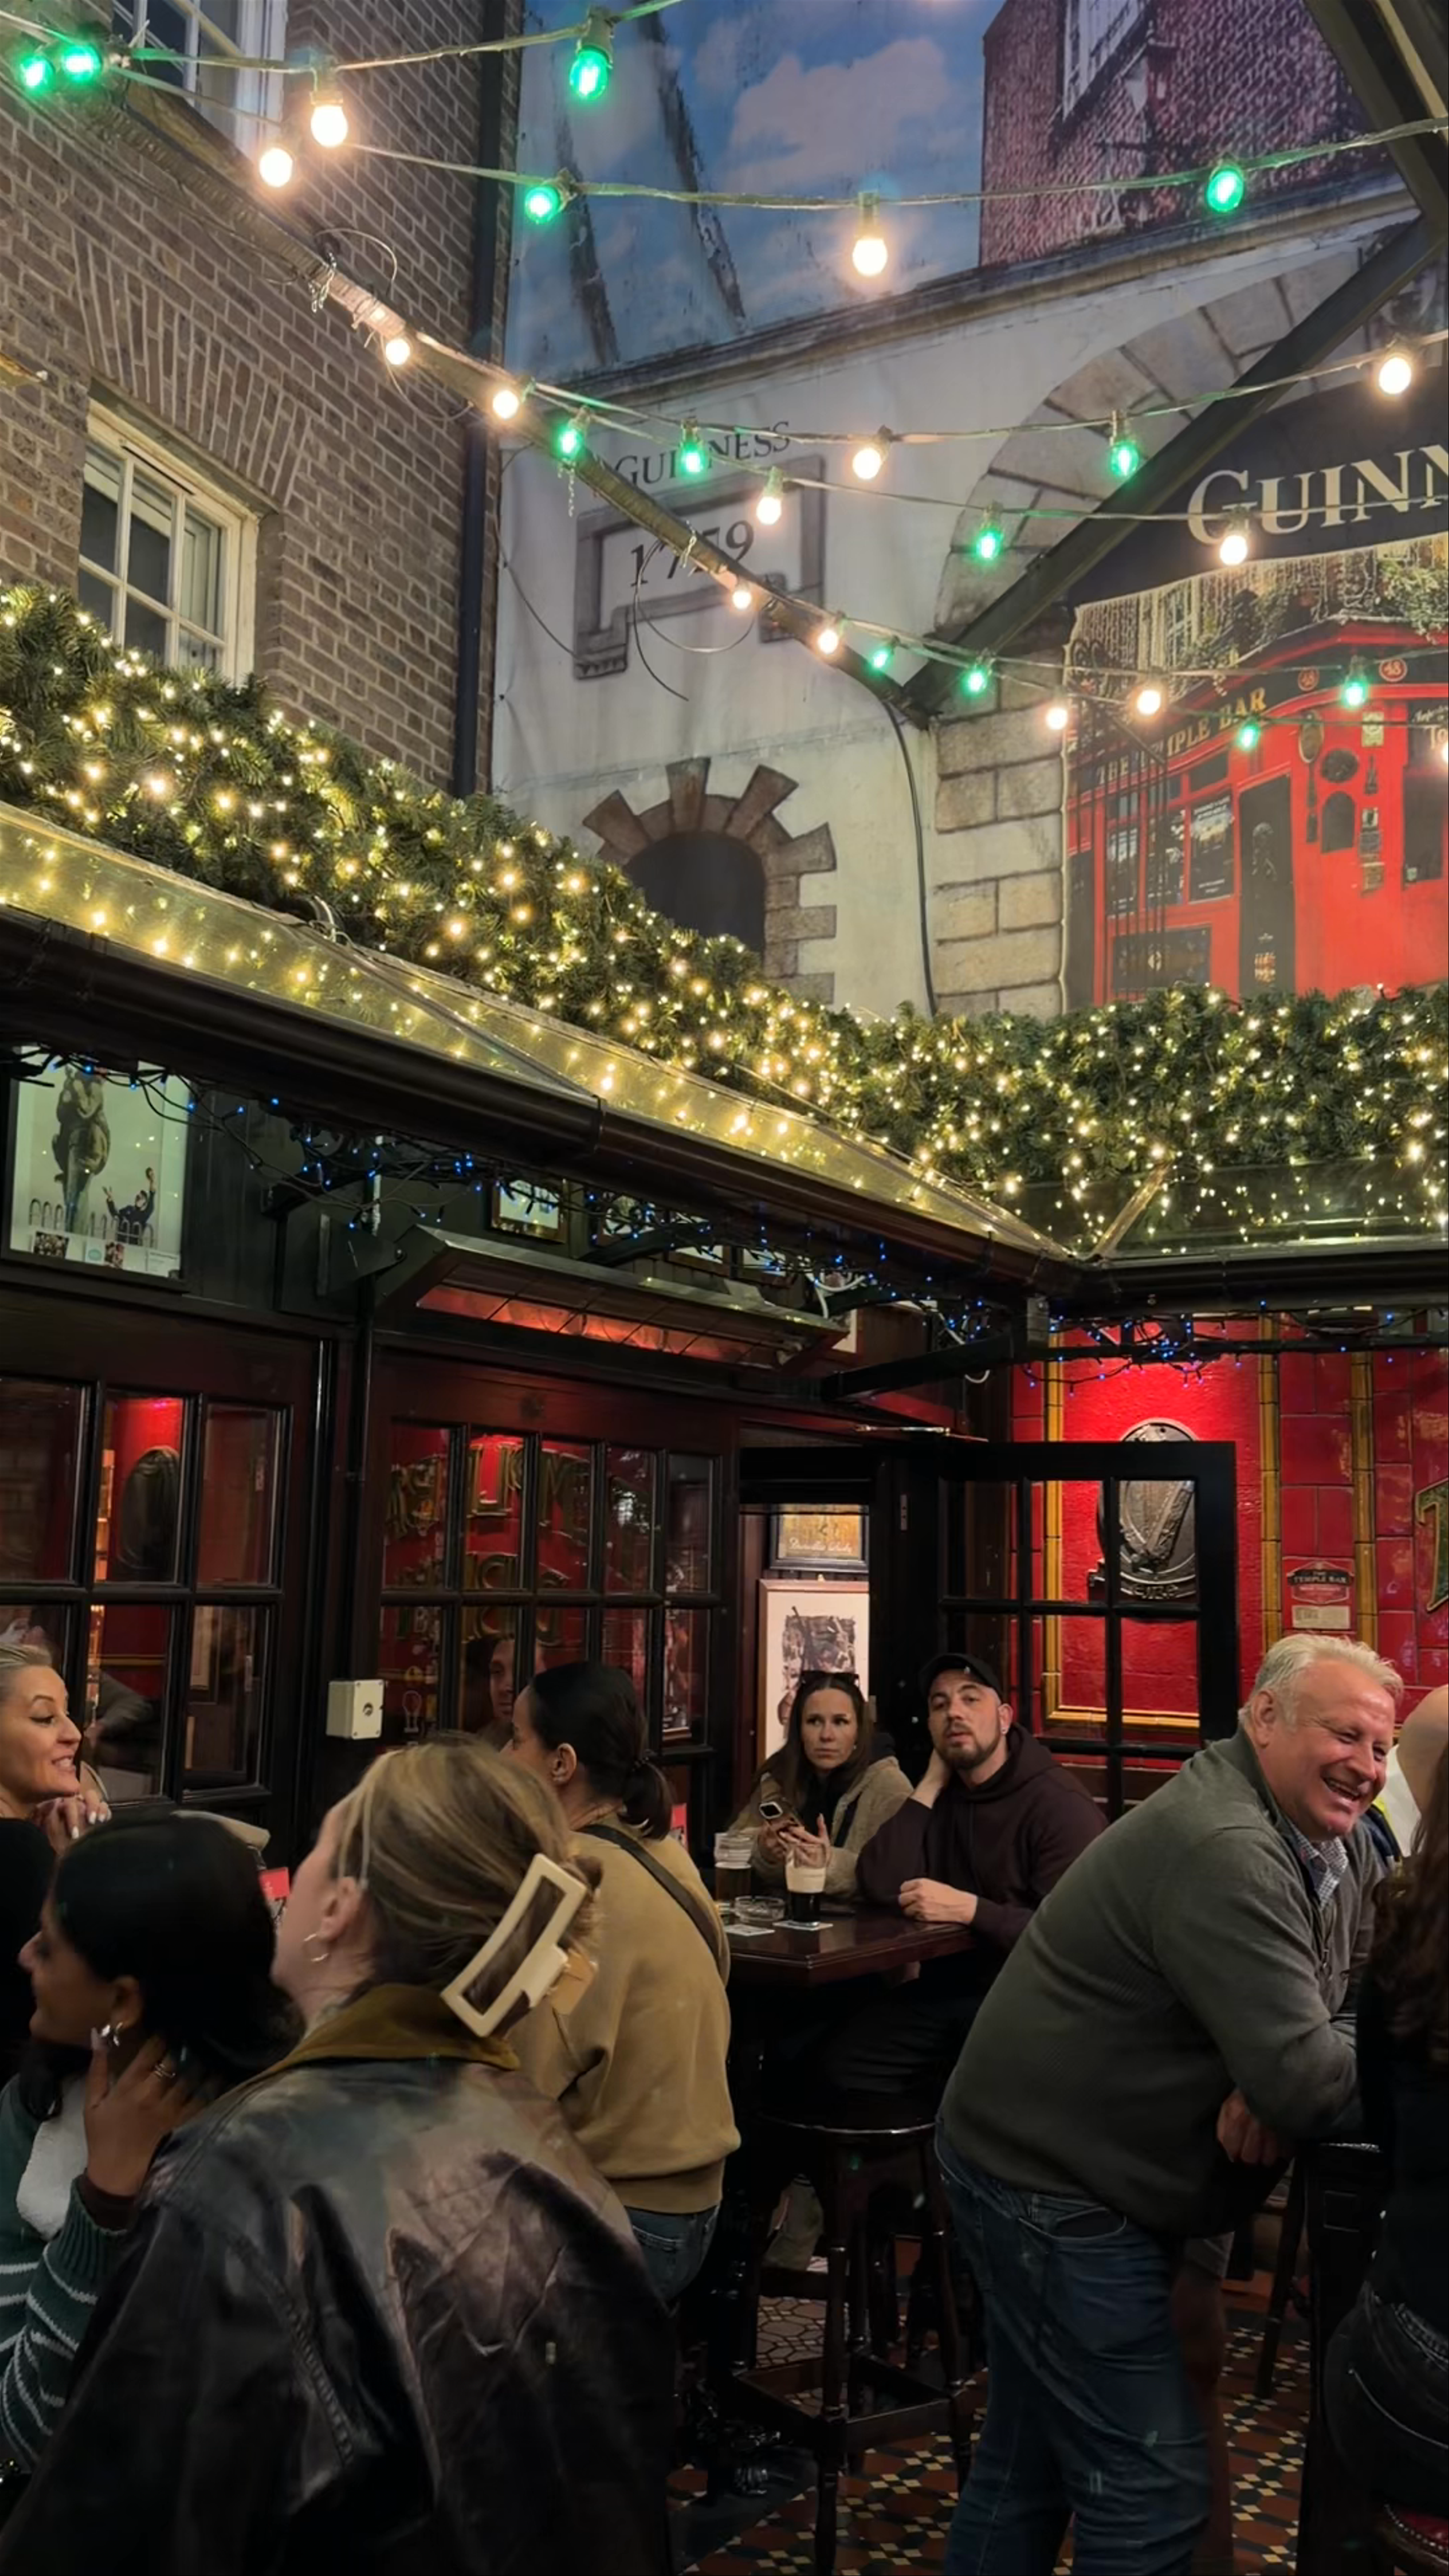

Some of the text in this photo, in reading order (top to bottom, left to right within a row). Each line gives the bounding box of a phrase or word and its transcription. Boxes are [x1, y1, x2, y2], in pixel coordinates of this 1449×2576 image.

[615, 421, 790, 486] GUINESS
[631, 520, 754, 587] 179
[1219, 687, 1266, 730] BAR
